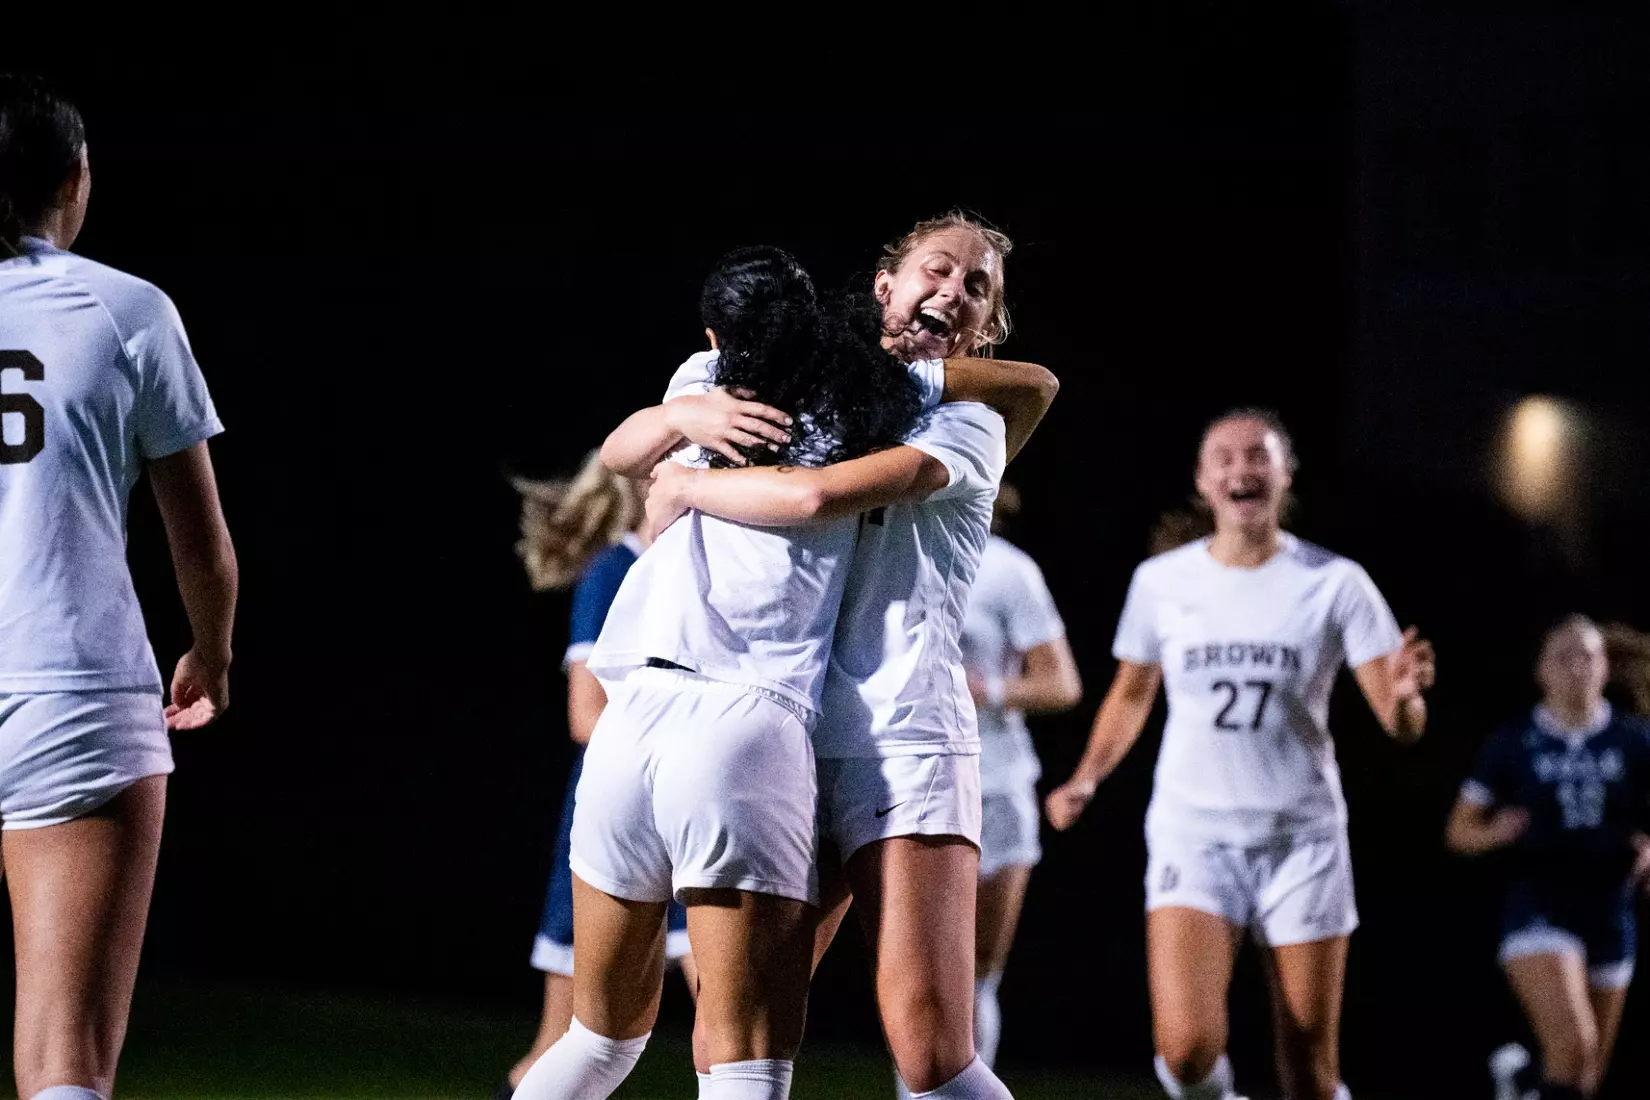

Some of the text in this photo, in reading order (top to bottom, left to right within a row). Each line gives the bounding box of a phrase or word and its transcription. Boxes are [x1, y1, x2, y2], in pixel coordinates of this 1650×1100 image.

[0, 349, 44, 464] 6
[1184, 642, 1302, 672] BROWN
[1211, 679, 1273, 731] 27
